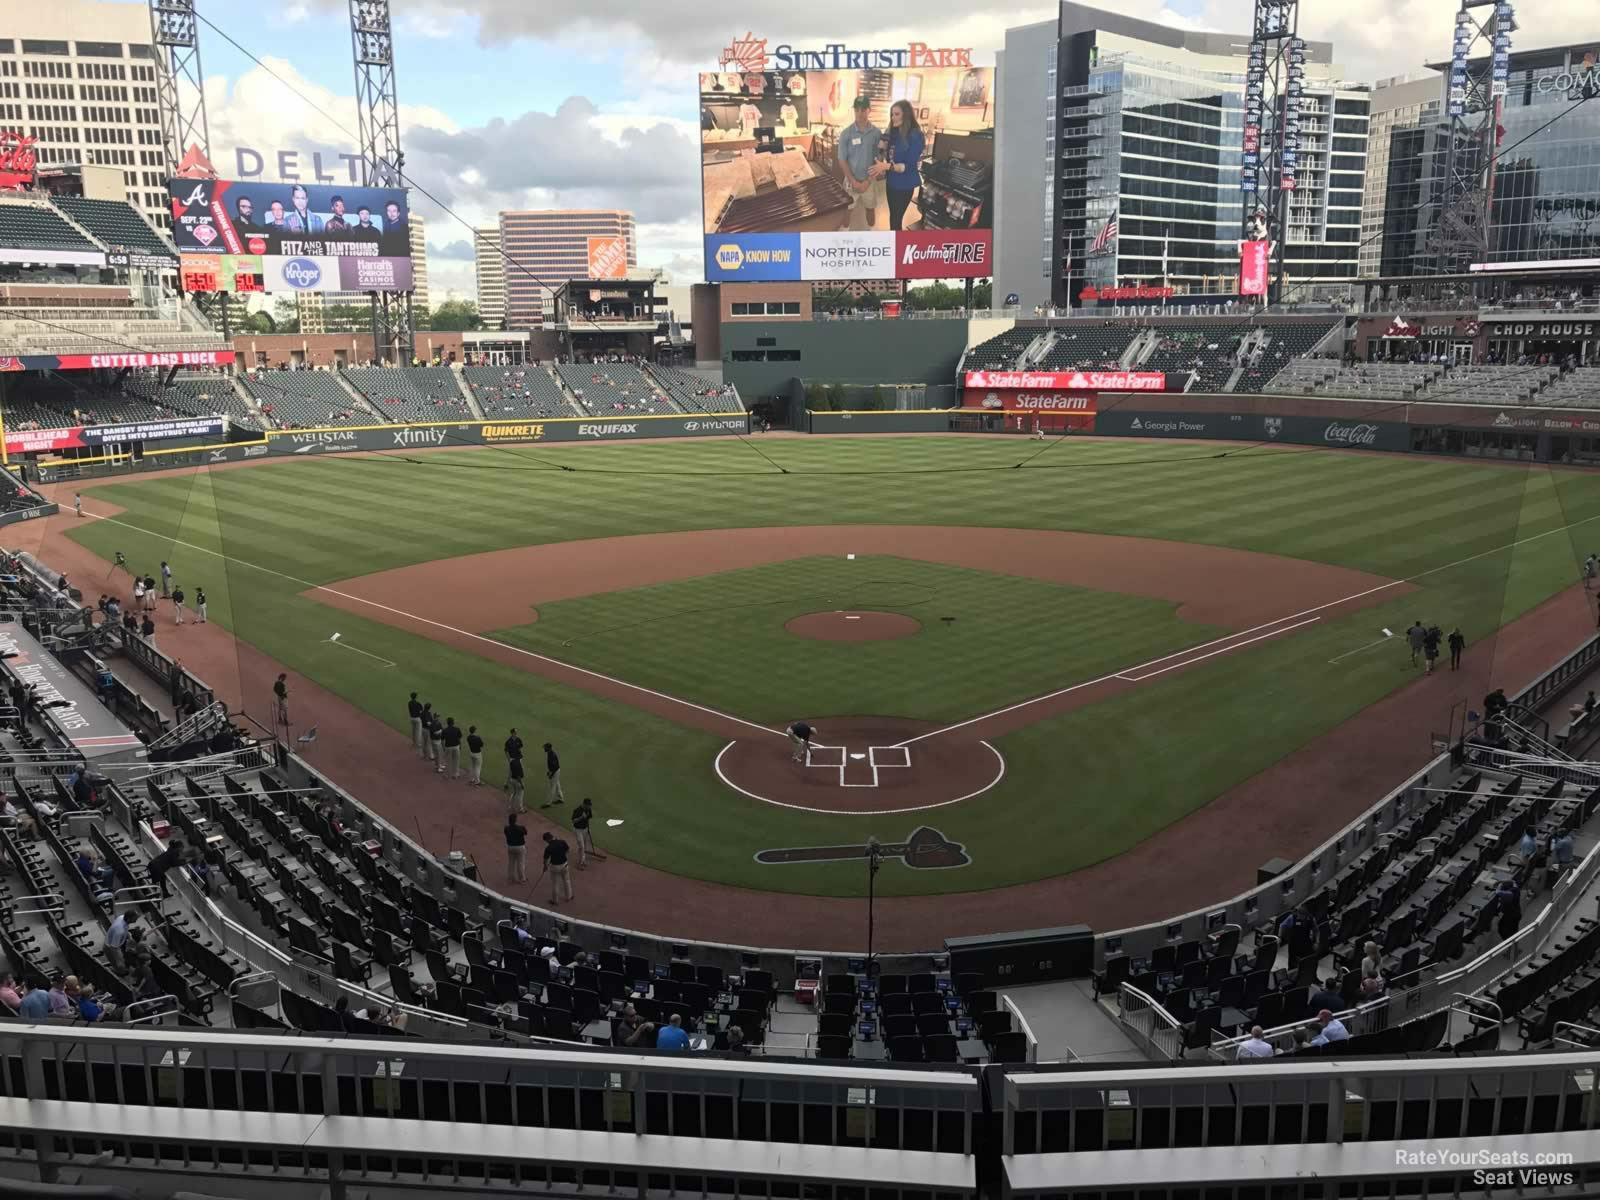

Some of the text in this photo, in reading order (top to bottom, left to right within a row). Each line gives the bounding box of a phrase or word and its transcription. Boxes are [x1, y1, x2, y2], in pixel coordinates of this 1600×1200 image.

[908, 42, 973, 68] PARK
[235, 147, 399, 188] DELTA
[281, 241, 379, 256] FITZ AND THE TANTRUMS
[805, 247, 891, 258] NORTHSIDE
[902, 243, 985, 264] Kauffman TIRE
[109, 255, 128, 264] 6:58
[720, 251, 740, 263] NAPA
[746, 250, 791, 263] KNOW HOW
[821, 260, 875, 268] HOSPITAL
[236, 274, 254, 285] 50
[286, 262, 319, 286] Kroger
[1421, 325, 1454, 336] LIGHT
[1494, 324, 1593, 336] CHOP HOUSE
[91, 351, 216, 368] CUTTER AND BUCK
[86, 419, 222, 437] THE DANSBY SWANSON BOBBLEHEAD
[481, 424, 545, 437] QUIKRETE
[578, 423, 638, 437] EQUIFAX
[702, 420, 745, 430] HYUNDAI
[1144, 420, 1205, 432] Georgia Power
[5, 430, 70, 443] BOBBLEHEAD
[103, 426, 209, 442] DIVES INTO SUNTRUST PARK!
[393, 427, 447, 447] xfinity
[24, 440, 54, 451] NIGHT
[15, 663, 48, 684] HOME
